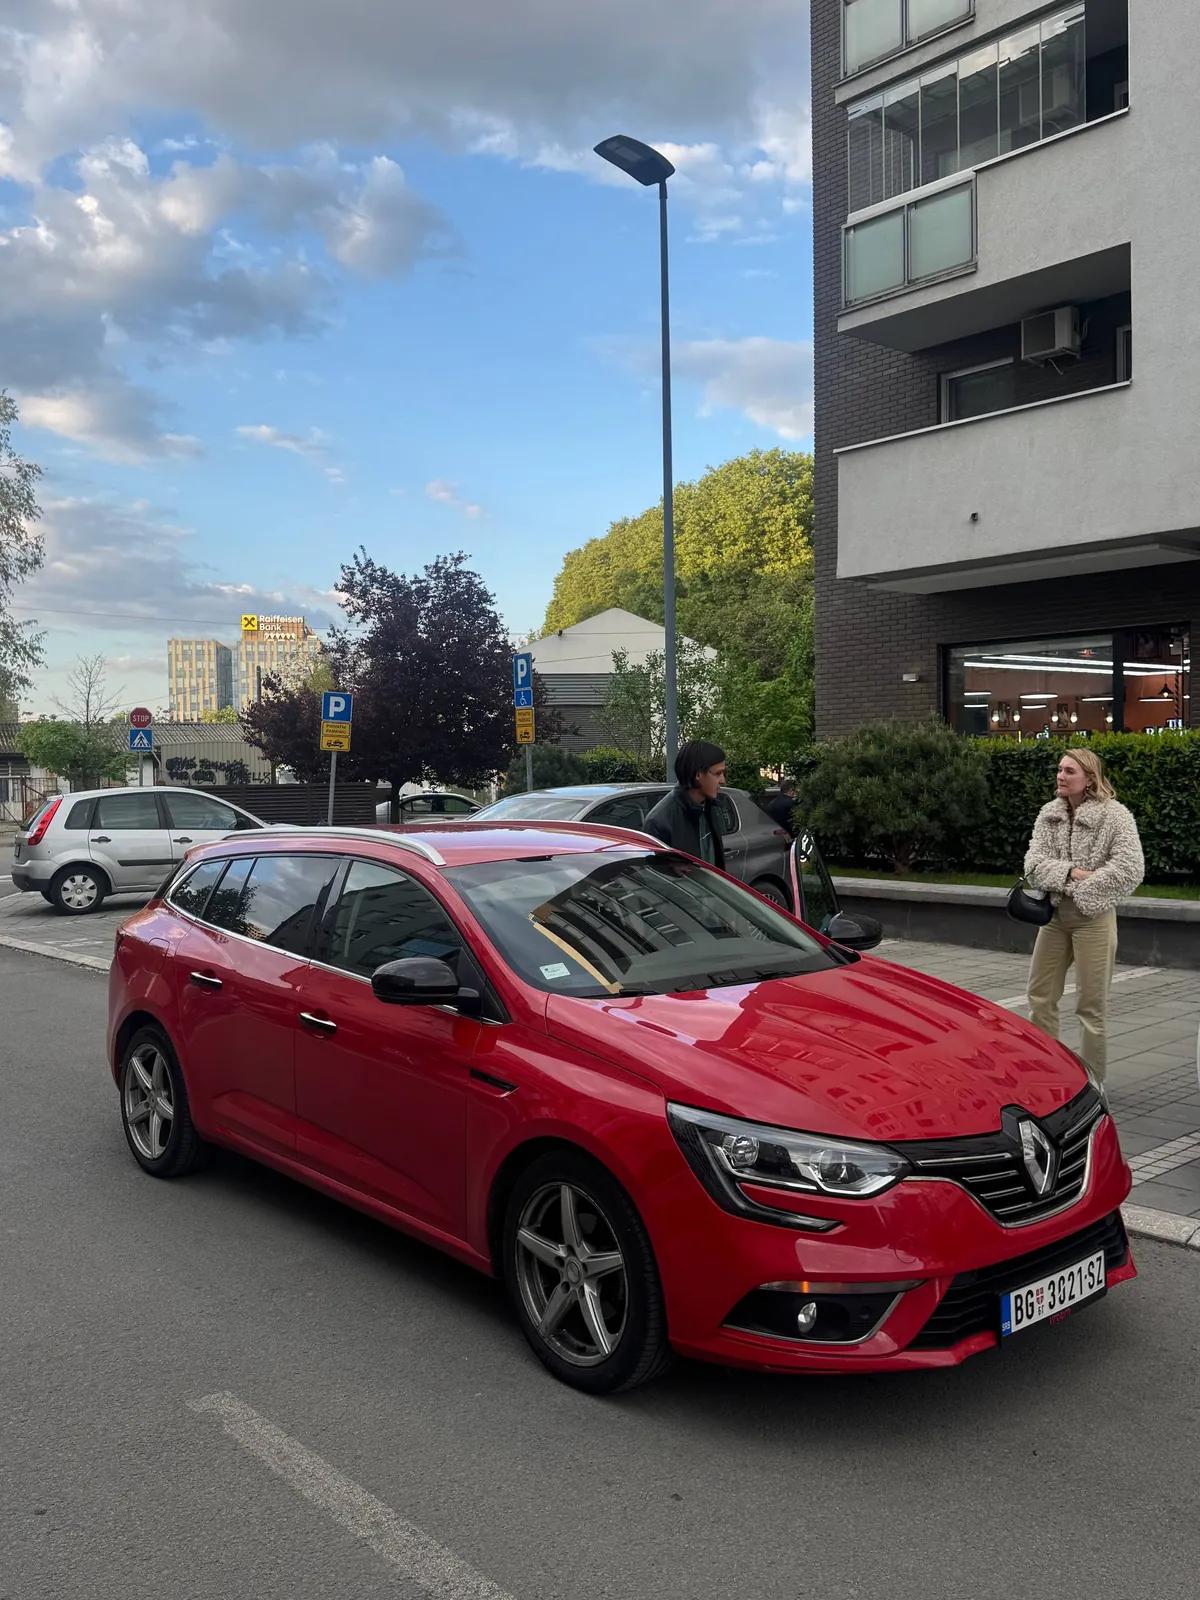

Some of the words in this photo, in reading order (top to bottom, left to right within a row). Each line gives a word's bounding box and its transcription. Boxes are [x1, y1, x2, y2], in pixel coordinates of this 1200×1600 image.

[259, 614, 303, 624] Raiffeisen
[259, 623, 281, 631] Bank
[518, 659, 527, 685] P
[329, 696, 346, 718] P
[132, 714, 150, 722] STOP
[1014, 1289, 1035, 1326] BG
